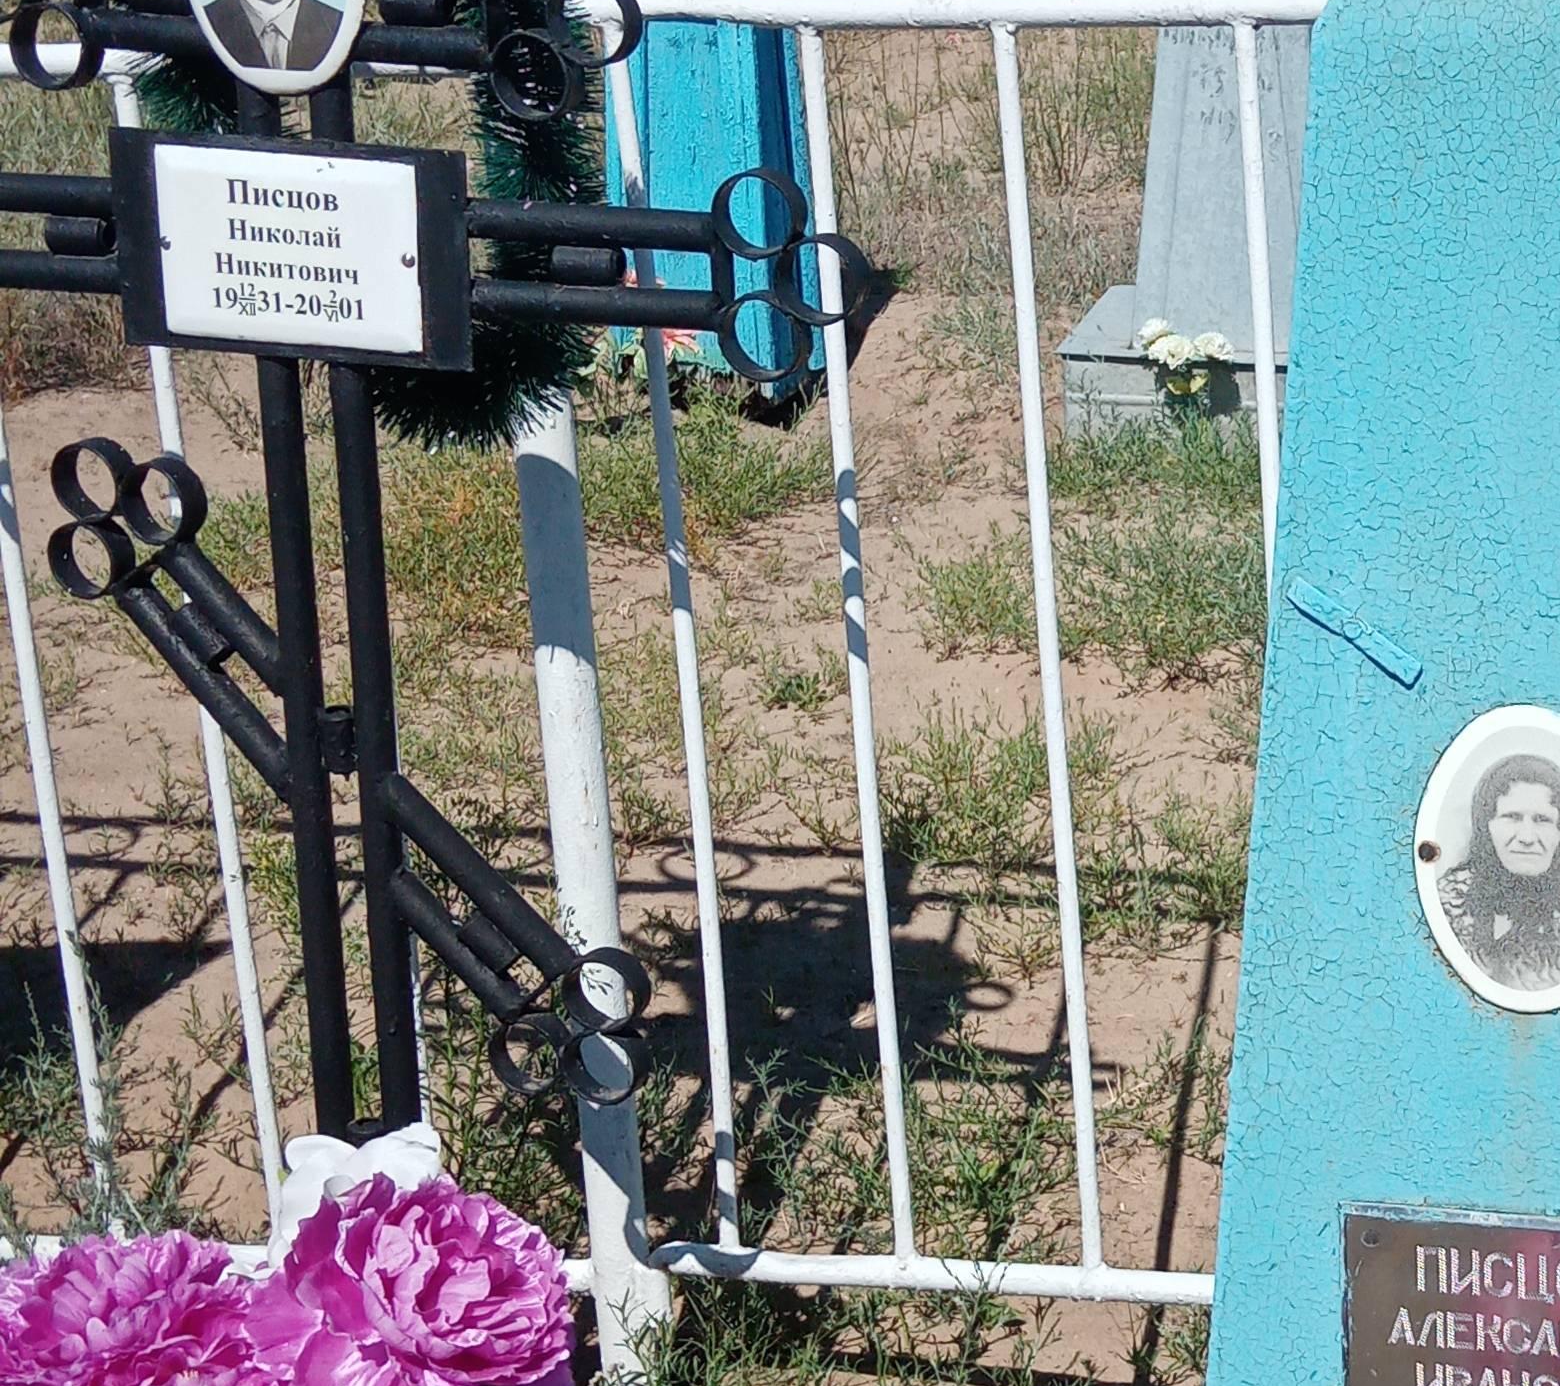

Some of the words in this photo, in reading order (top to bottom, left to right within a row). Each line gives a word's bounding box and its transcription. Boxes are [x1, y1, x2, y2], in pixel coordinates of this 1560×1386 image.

[225, 178, 340, 213] Писцов
[228, 217, 341, 249] Николай
[215, 252, 360, 286] Никитович
